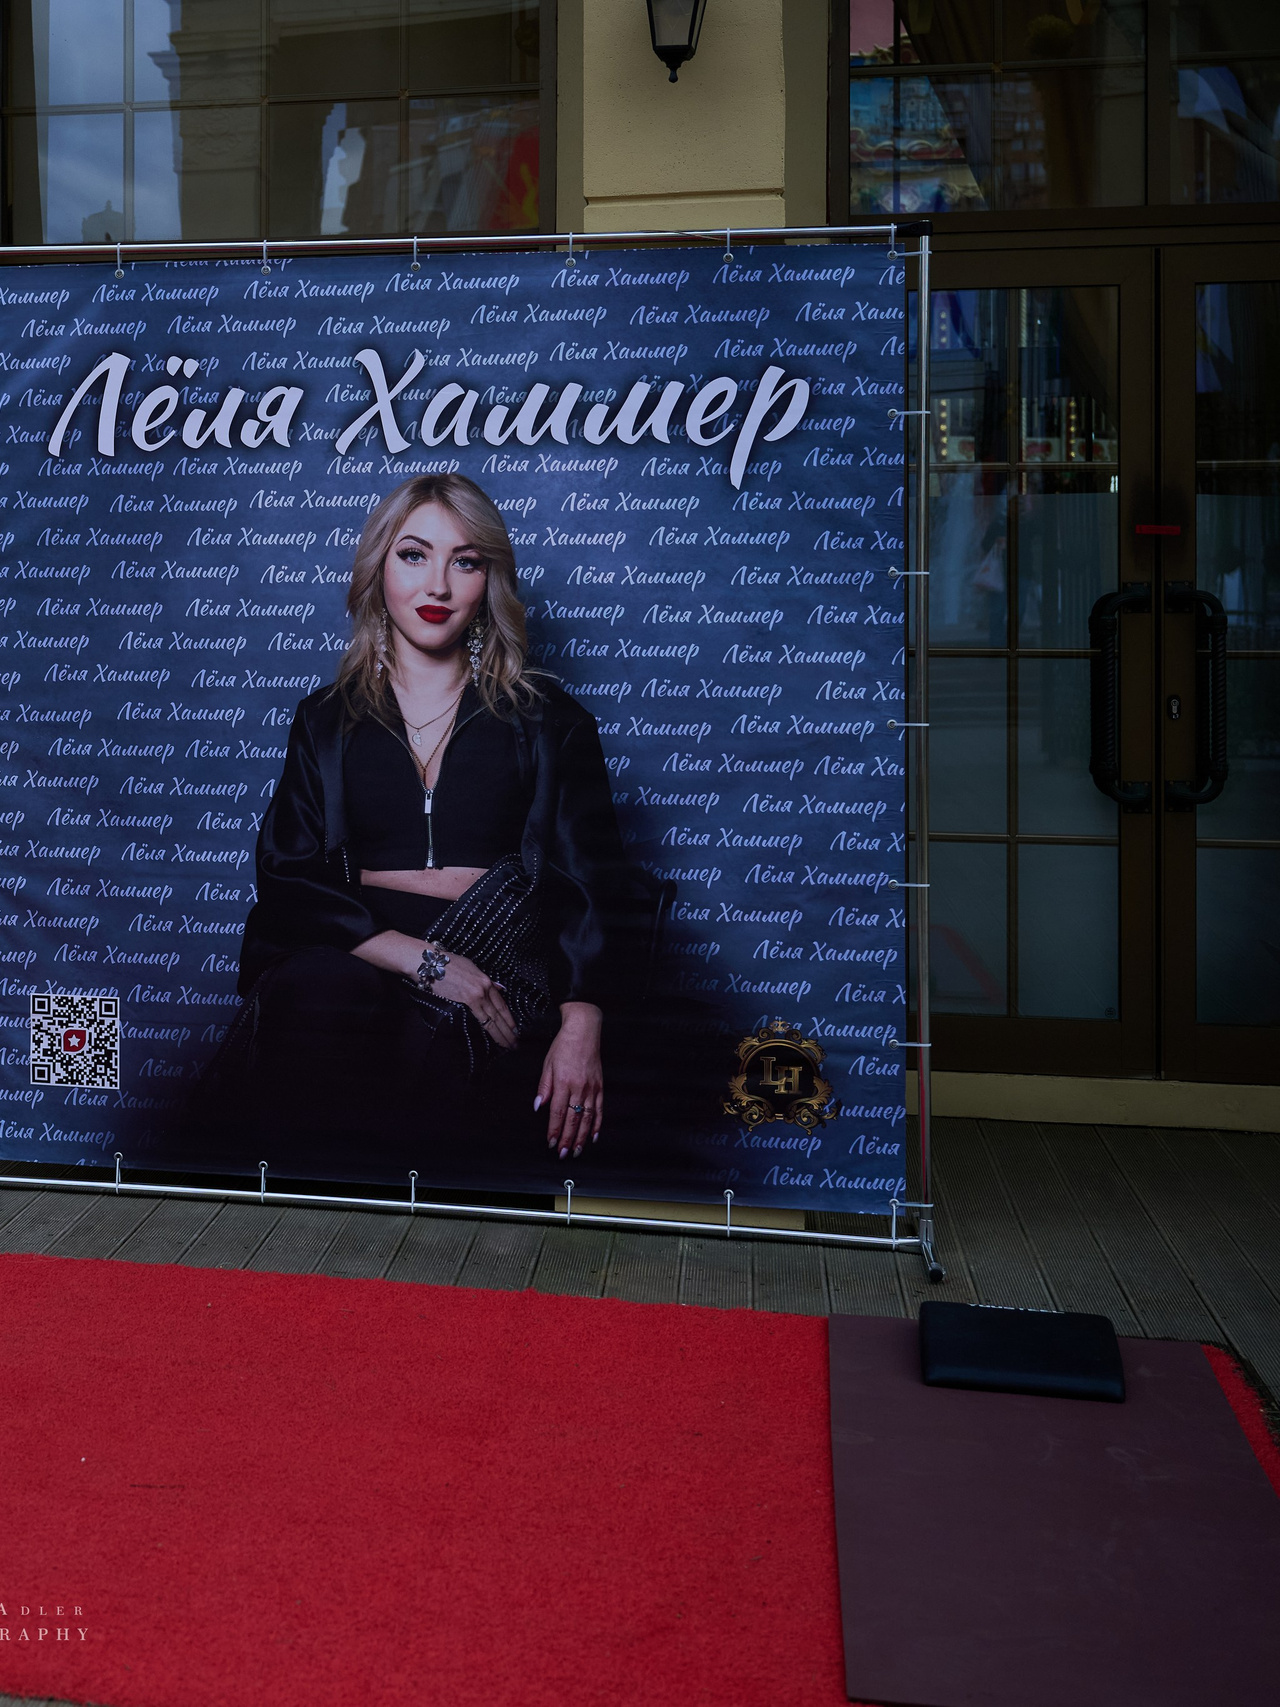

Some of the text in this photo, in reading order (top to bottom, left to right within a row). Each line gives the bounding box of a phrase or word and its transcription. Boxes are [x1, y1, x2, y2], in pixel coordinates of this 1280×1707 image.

[92, 283, 219, 306] Лёля Хаммер
[244, 277, 374, 303] Лёля Хаммер
[167, 314, 296, 338] Лёля Хаммер
[630, 304, 770, 329] Лёля Хаммер
[549, 341, 688, 366] Лёля Хаммер
[714, 338, 857, 363] Лёля Хаммер
[47, 347, 810, 491] Лёля Хаммер
[173, 457, 302, 481] Лёля Хаммер
[482, 454, 618, 479] Лёля Хаммер
[110, 494, 237, 519] Лёля Хаммер
[561, 492, 699, 517] Лёля Хаммер
[37, 528, 163, 552] Лёля Хаммер
[649, 526, 790, 552] Лёля Хаммер
[37, 598, 163, 623] Лёля Хаммер
[643, 604, 783, 631] Лёля Хаммер
[119, 631, 246, 657] Лёля Хаммер
[722, 644, 865, 671] Лёля Хаммер
[44, 663, 170, 689] Лёля Хаммер
[641, 678, 782, 706] Лёля Хаммер
[117, 702, 245, 728] Лёля Хаммер
[662, 752, 804, 781] Лёля Хаммер
[23, 770, 99, 795] Хаммер
[743, 793, 887, 822] Лёля Хаммер
[661, 826, 802, 856] Лёля Хаммер
[54, 943, 180, 972] Лёля Хаммер
[753, 939, 898, 970] Лёля Хаммер
